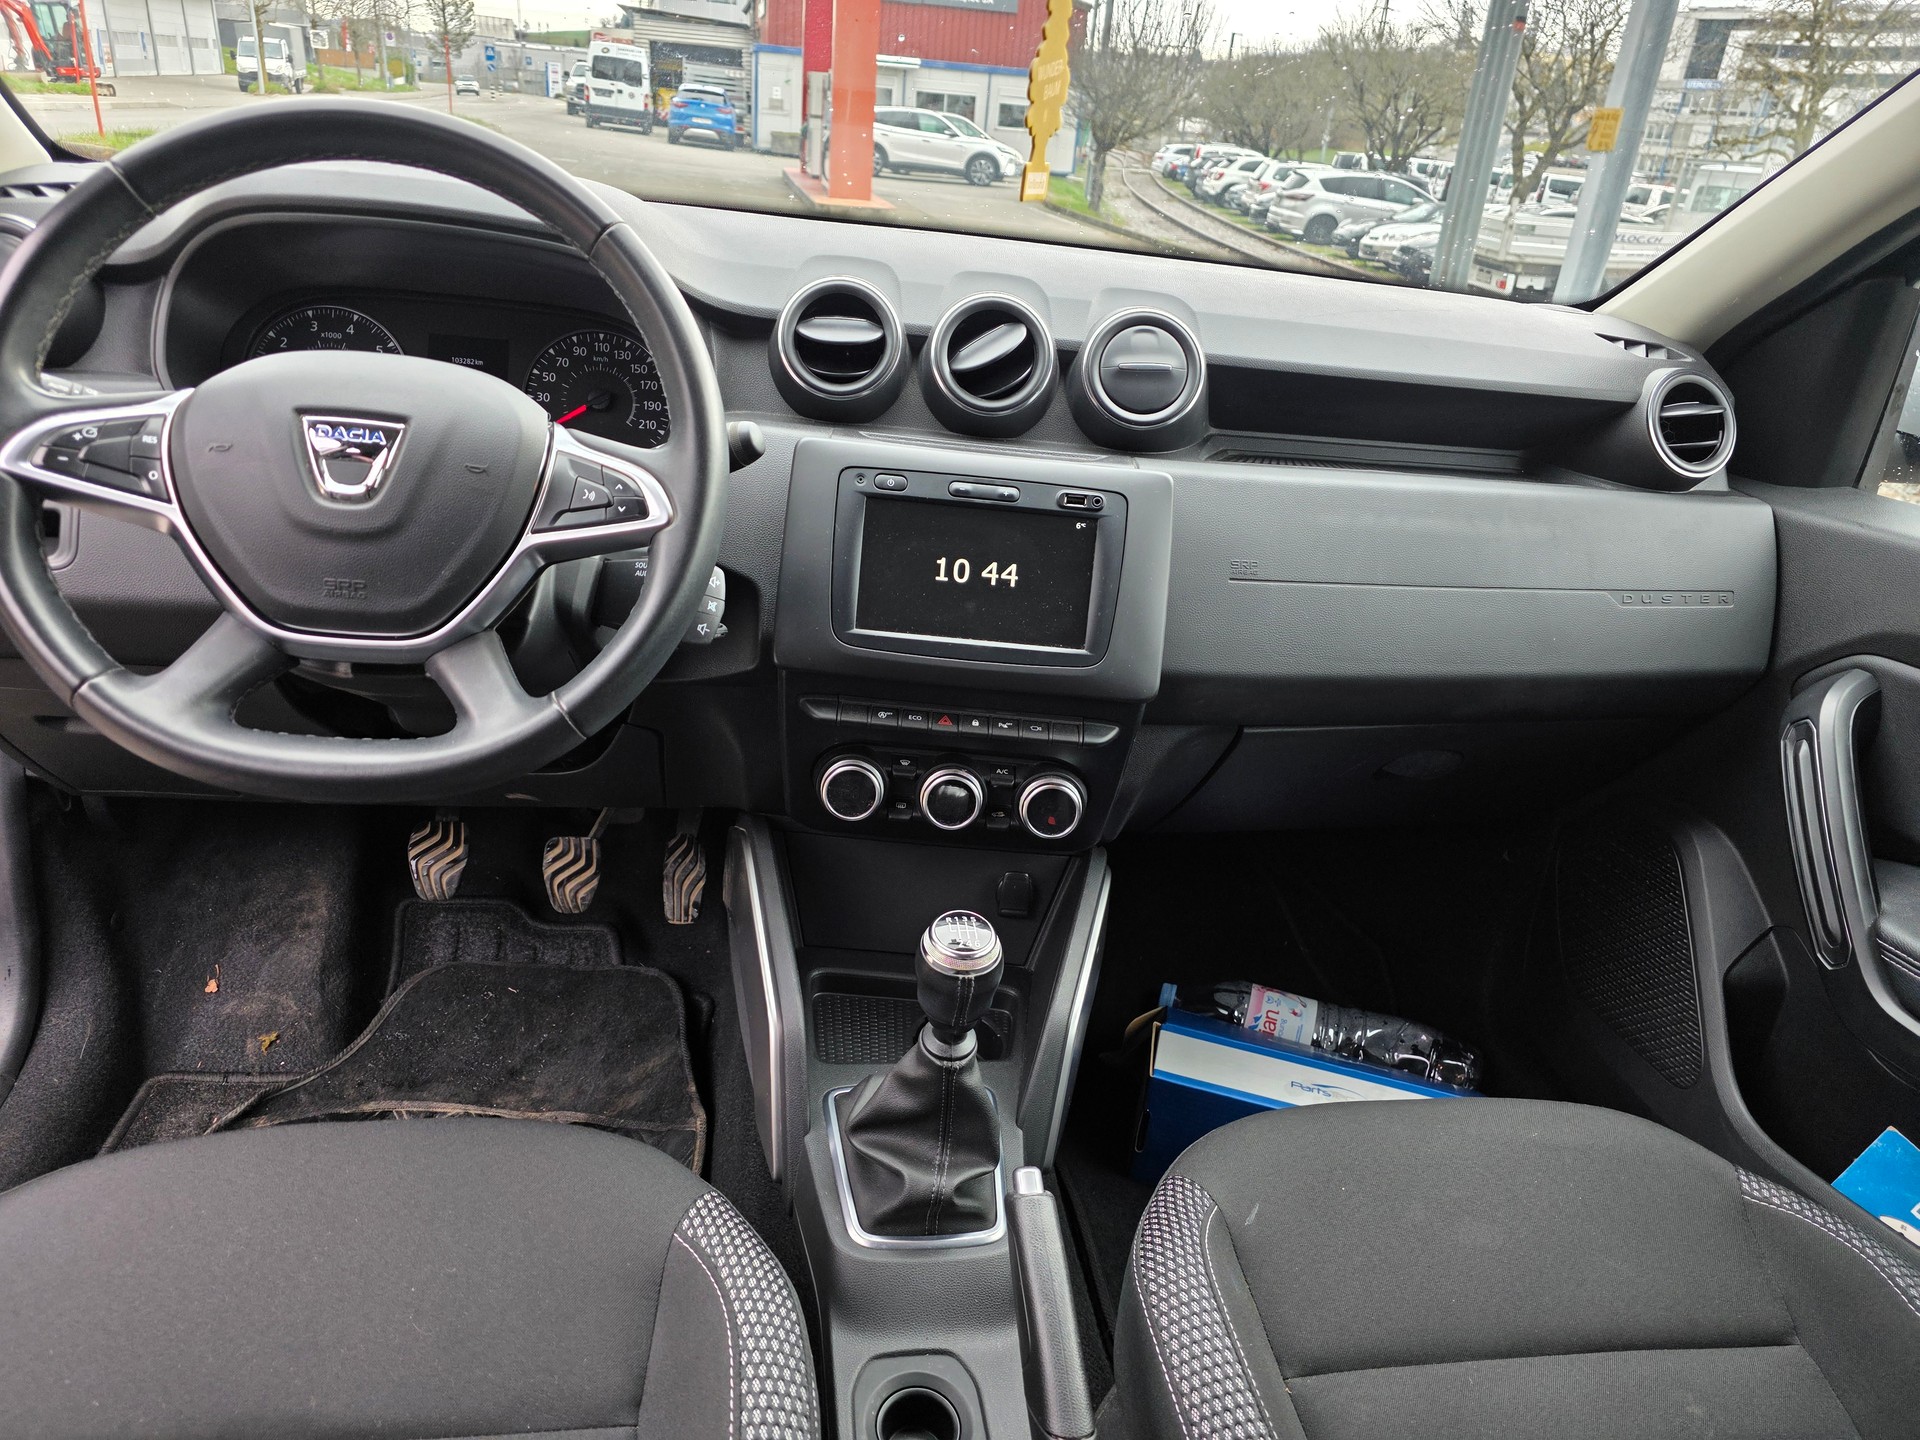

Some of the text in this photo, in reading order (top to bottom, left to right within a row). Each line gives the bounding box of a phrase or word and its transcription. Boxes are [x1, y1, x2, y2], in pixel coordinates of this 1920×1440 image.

[310, 321, 318, 332] 3
[346, 324, 354, 335] 4
[279, 337, 287, 348] 2
[594, 342, 610, 353] 110
[573, 346, 587, 357] 90
[614, 350, 632, 361] 130
[451, 356, 475, 365] 103282
[556, 357, 569, 367] 70
[593, 355, 609, 363] km/h
[630, 364, 648, 374] 150
[542, 372, 556, 383] 50
[640, 380, 658, 391] 170
[536, 392, 550, 402] 30
[643, 400, 662, 411] 190
[638, 419, 657, 430] 210
[142, 435, 158, 444] RES
[315, 424, 387, 445] DACIA
[934, 557, 1018, 588] 10 44
[1621, 593, 1729, 605] DUSTER
[959, 940, 980, 948] 2 4 6
[1290, 1080, 1332, 1098] Parts
